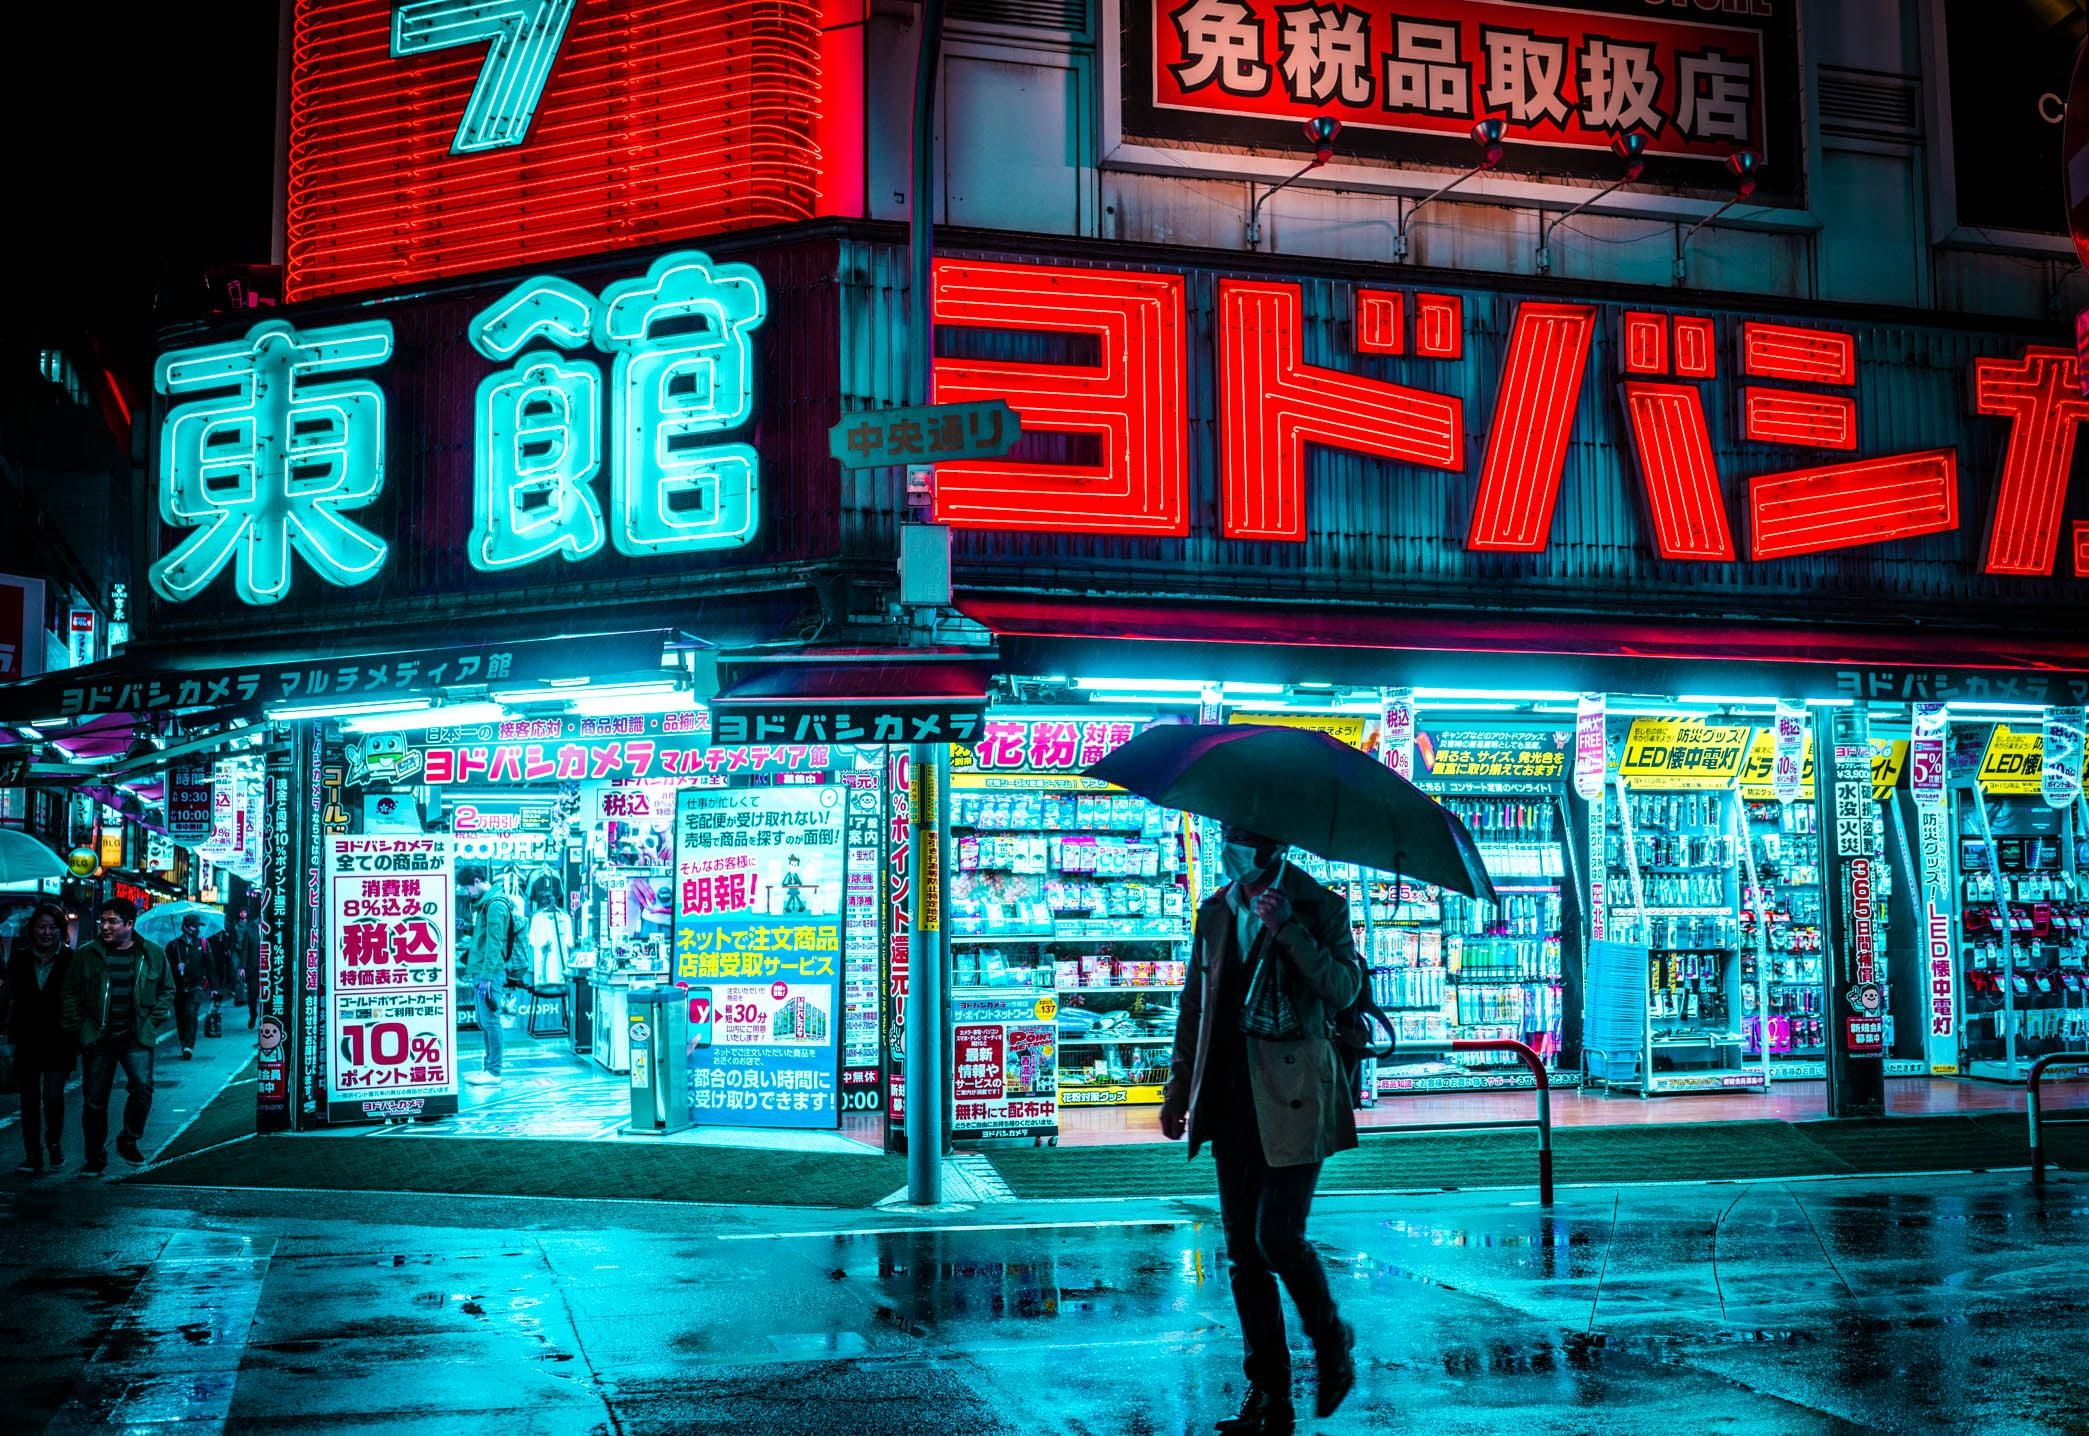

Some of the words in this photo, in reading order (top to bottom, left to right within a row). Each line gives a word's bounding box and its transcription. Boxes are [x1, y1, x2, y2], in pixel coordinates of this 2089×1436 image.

[1176, 0, 1750, 142] 免税品取扱店
[149, 249, 770, 606] 東館
[847, 408, 1005, 459] 中央通り
[59, 673, 261, 714] ヨドバシカメラ
[1835, 670, 2049, 699] ヨドバシカメラ
[719, 713, 978, 743] ヨドバシカメラ
[1677, 727, 1747, 744] 防災グッズ!
[976, 721, 1079, 768] 花粉
[1578, 732, 1602, 749] FREE
[424, 740, 656, 784] ヨドバシカメラ
[659, 742, 830, 776] マルチメディア館
[1624, 746, 1740, 770] LED懐中電灯
[1984, 752, 2043, 776] LED懐
[180, 791, 208, 803] 9:30
[602, 793, 650, 818] 税込
[687, 795, 760, 810] 仕事が忙しくて
[1838, 783, 1858, 817] 水没
[177, 810, 210, 821] 10:00
[685, 810, 831, 830] 宅配便が受け取れない!
[335, 839, 445, 854] ヨドバシカメラは
[684, 828, 840, 849] 売場で商品を探すのが面倒!
[1840, 821, 1860, 854] 火災
[335, 853, 446, 873] 全ての商品が
[679, 854, 757, 875] そんなお客様に
[1922, 812, 1941, 901] 防災グッズ!
[361, 878, 421, 898] 消費税
[680, 873, 759, 916] 朗報!
[342, 898, 438, 918] 8%込みの
[1851, 858, 1875, 985] 365日間補償
[341, 921, 438, 967] 税込
[676, 925, 839, 951] ネットで注文商品
[677, 952, 835, 978] 店舗受取サービス
[1928, 903, 1951, 1036] LED懐中電灯
[339, 966, 443, 987] 特価表示です
[339, 993, 443, 1008] ゴールドポイントカード
[1041, 1005, 1056, 1014] 137
[384, 1005, 445, 1018] ご利用で更に
[733, 1003, 768, 1024] 30分
[953, 1008, 1035, 1021] ザ・ポイントネットワーク
[342, 1021, 441, 1067] 10%
[713, 1048, 817, 1059] ネットでご注文いただいた商品を
[965, 1047, 994, 1063] 最新
[340, 1065, 445, 1088] ポイント還元
[957, 1063, 1000, 1079] 情報や
[955, 1078, 1002, 1090] サービスの
[362, 1098, 425, 1112] ヨドバシカメラ
[1061, 1090, 1128, 1103] 花粉対策グッズ
[955, 1100, 1056, 1121] 無料にて配布中
[981, 1128, 1029, 1138] ヨドバシカメラ
